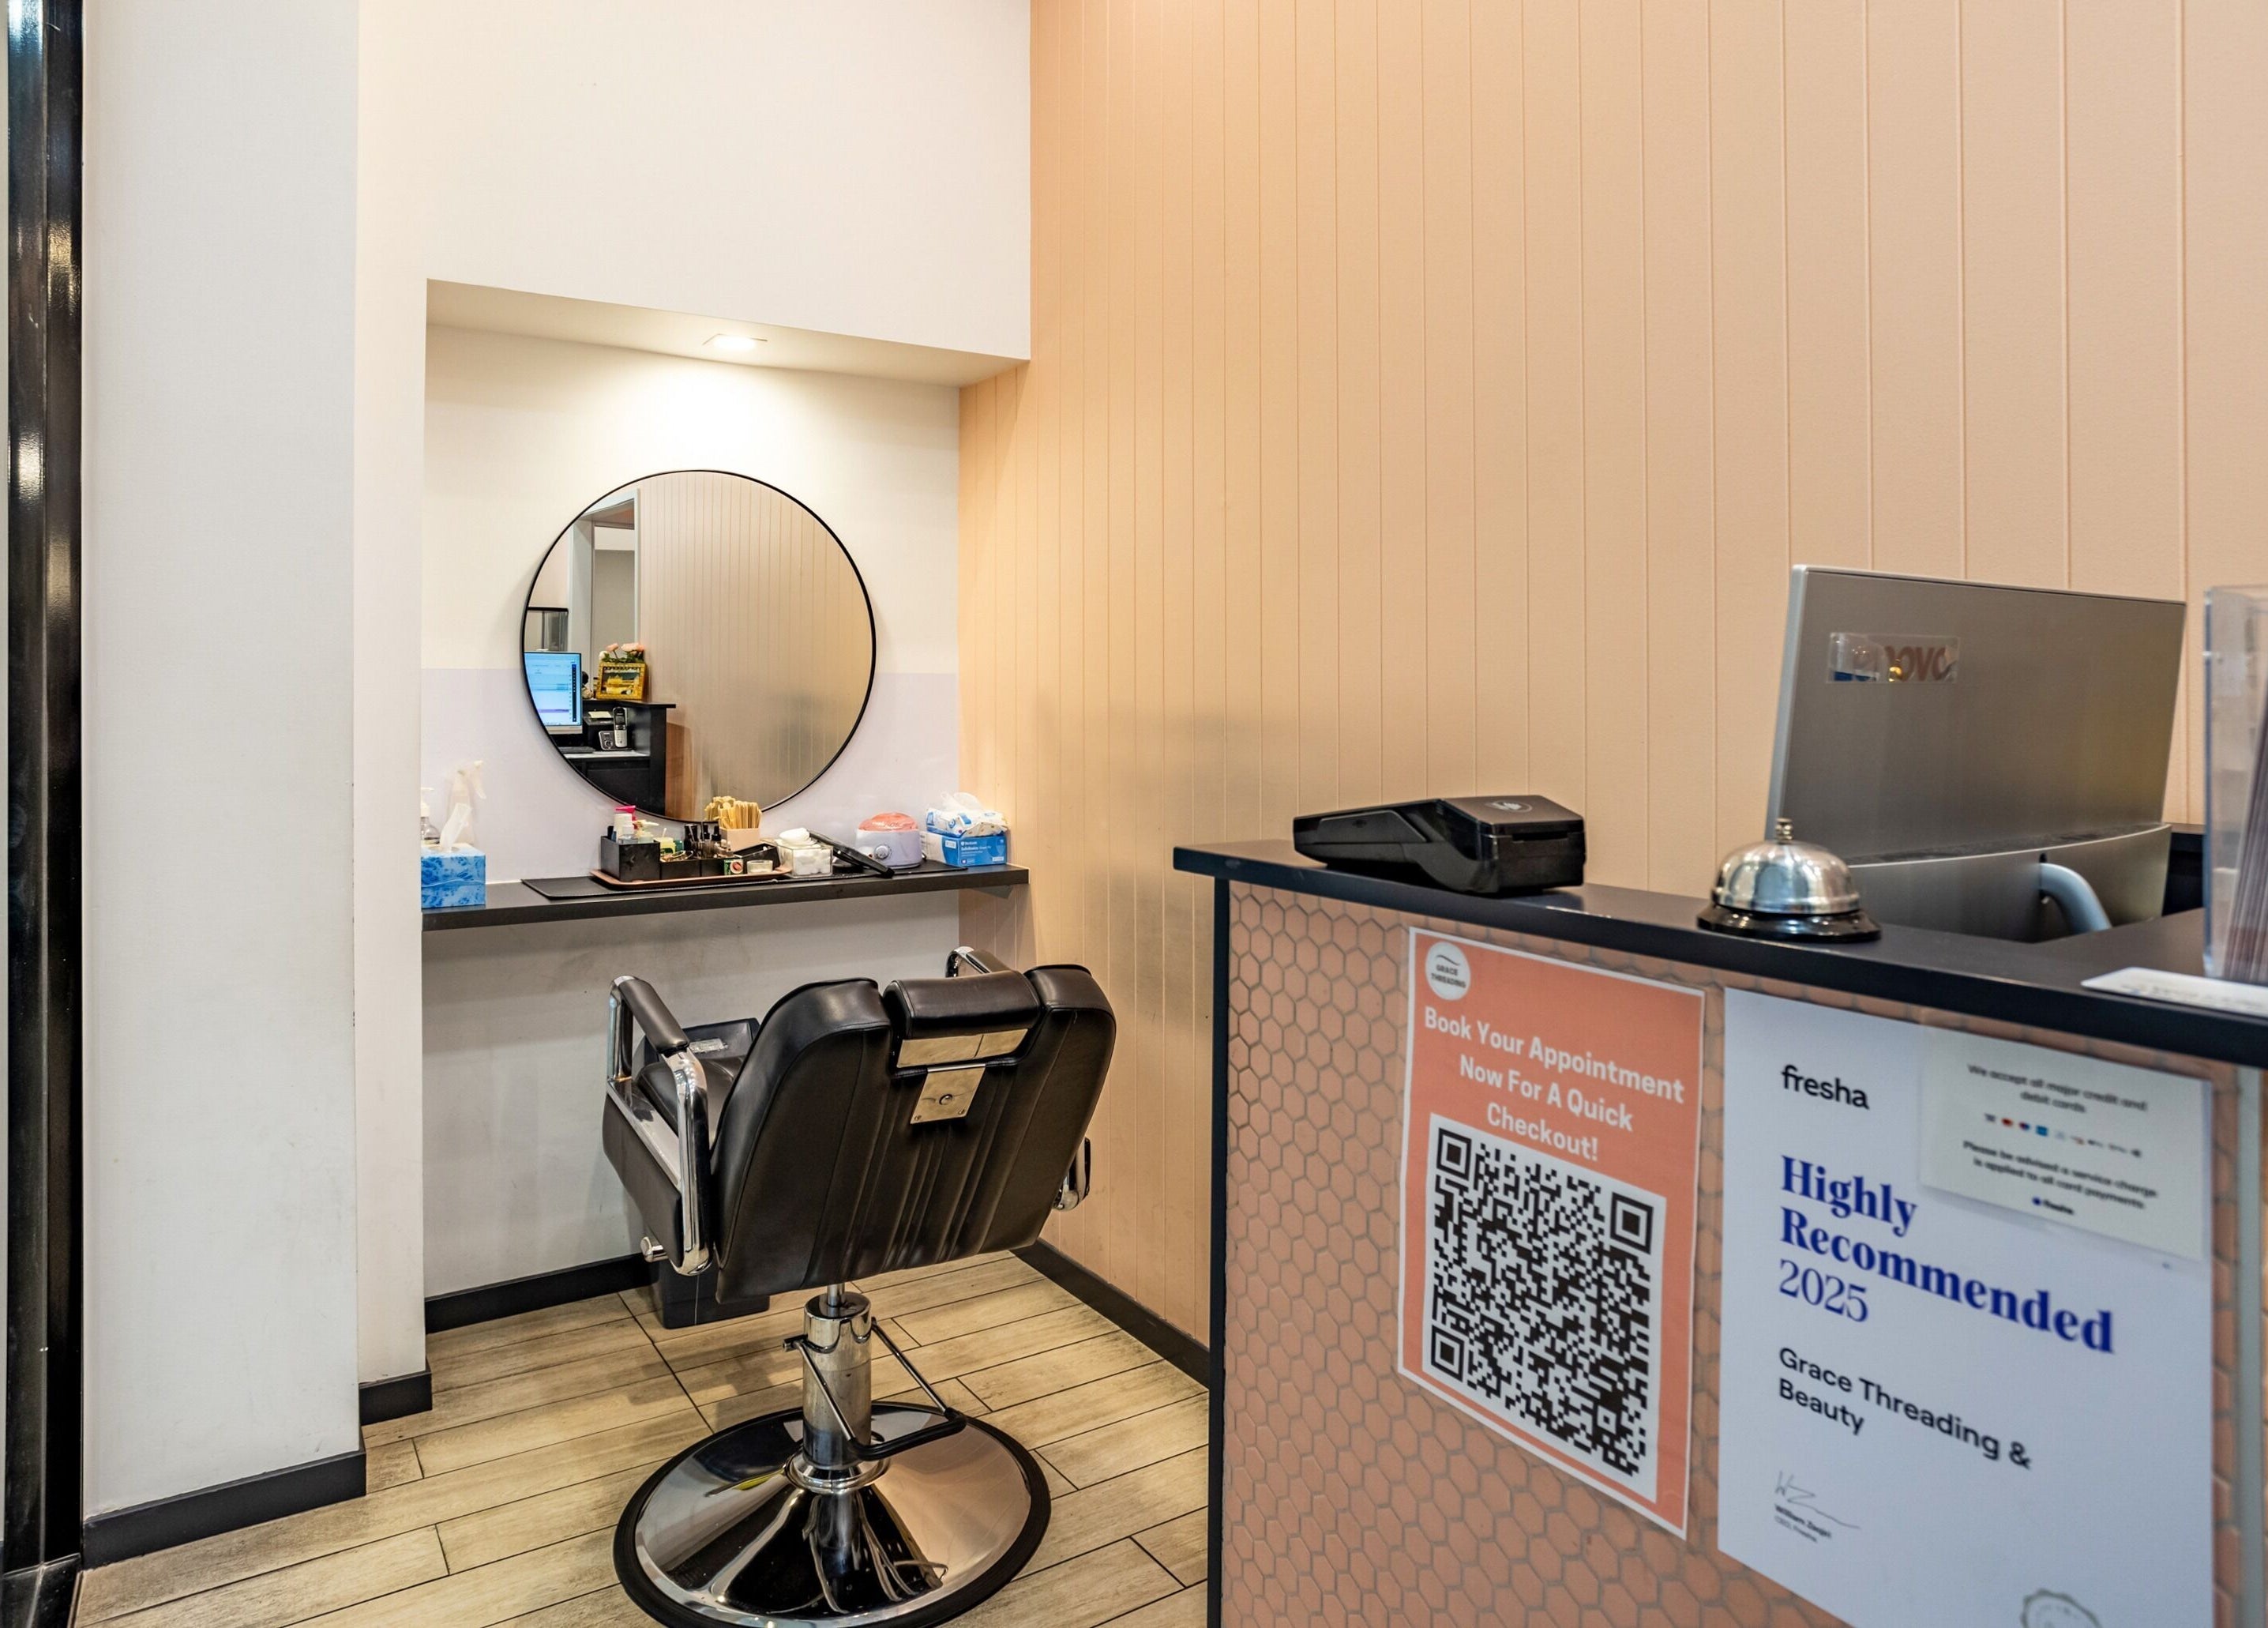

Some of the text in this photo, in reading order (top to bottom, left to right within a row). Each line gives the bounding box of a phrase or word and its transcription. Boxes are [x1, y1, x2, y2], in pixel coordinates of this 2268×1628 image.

[1425, 1006, 1685, 1104] Book Your Appointment
[1459, 1055, 1633, 1132] Now For A Quick
[1781, 1064, 1869, 1110] fresha
[1487, 1103, 1598, 1161] Checkout!
[1780, 1154, 1918, 1238] Highly
[1779, 1259, 1868, 1323] 2025
[1780, 1206, 2115, 1354] Recommended
[1778, 1378, 1864, 1436] Beauty
[1778, 1347, 2032, 1470] Grace Threading &
